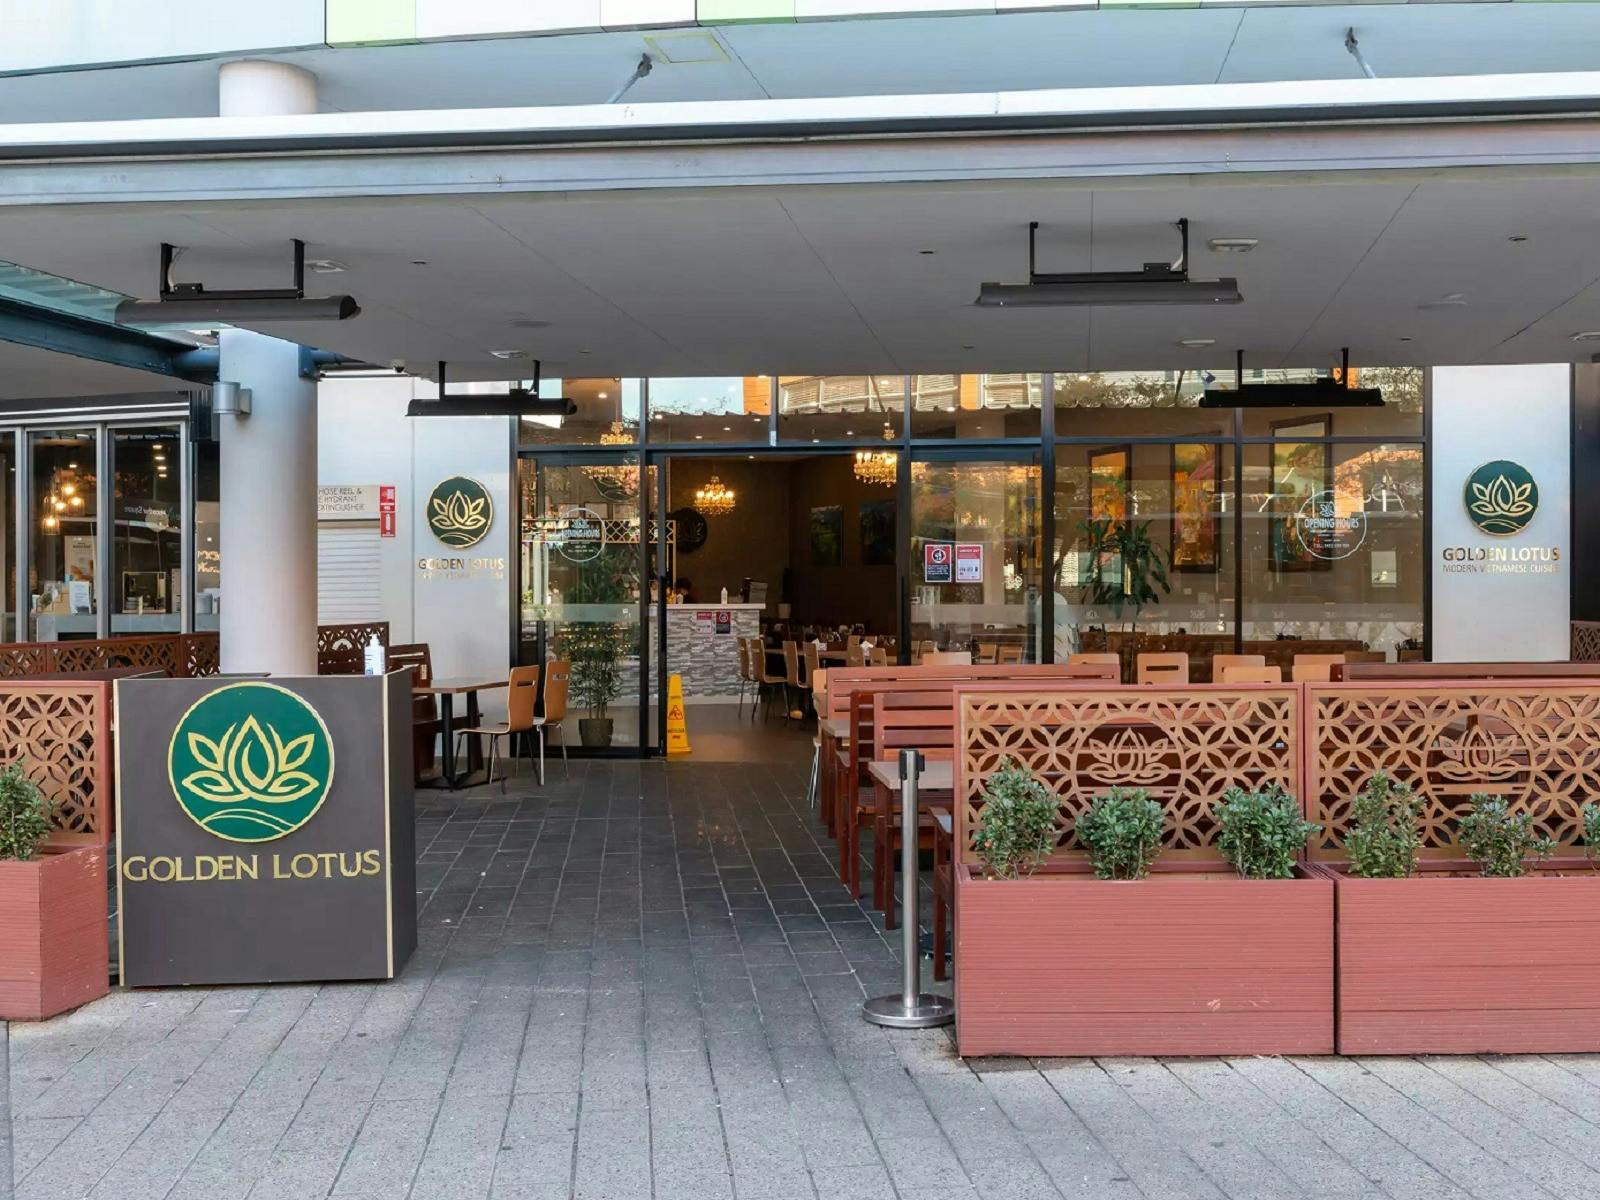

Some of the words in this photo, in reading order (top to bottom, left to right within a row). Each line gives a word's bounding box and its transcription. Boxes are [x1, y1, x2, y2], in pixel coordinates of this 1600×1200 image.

[318, 488, 338, 497] HOSE
[340, 488, 355, 496] REEL
[324, 496, 357, 505] HYDRANT
[1304, 518, 1335, 529] OPENING
[1335, 518, 1360, 529] HOURS
[1442, 547, 1507, 562] GOLDEN
[1511, 547, 1561, 562] LOTUS
[418, 558, 465, 571] GOLDEN
[1442, 564, 1477, 574] MODERN
[122, 854, 259, 882] GOLDEN
[273, 849, 381, 879] LOTUS
